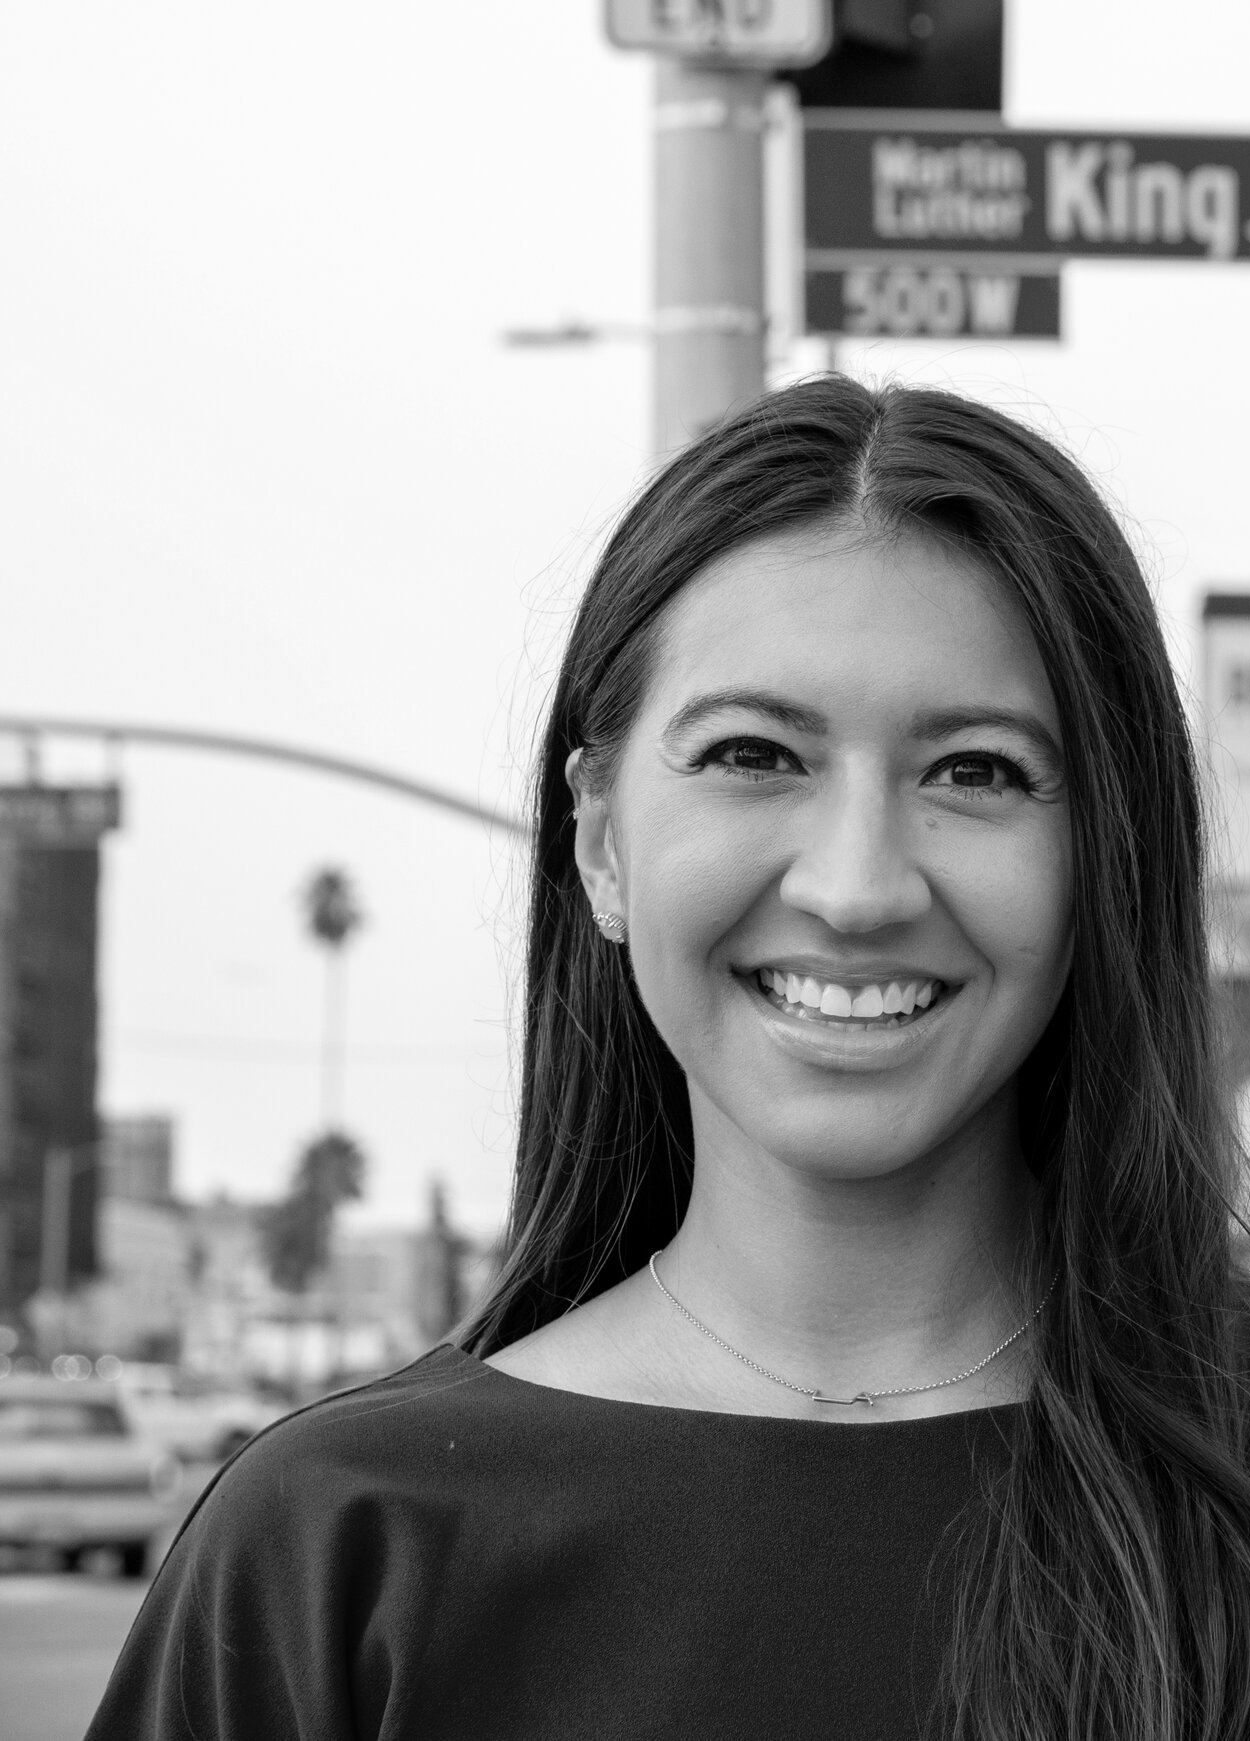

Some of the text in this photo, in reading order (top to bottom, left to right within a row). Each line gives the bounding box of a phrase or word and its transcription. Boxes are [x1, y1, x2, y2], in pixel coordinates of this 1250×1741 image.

[872, 136, 1027, 186] Martin
[872, 186, 1031, 240] Luther
[1045, 139, 1240, 259] King
[841, 266, 1021, 334] 500 W
